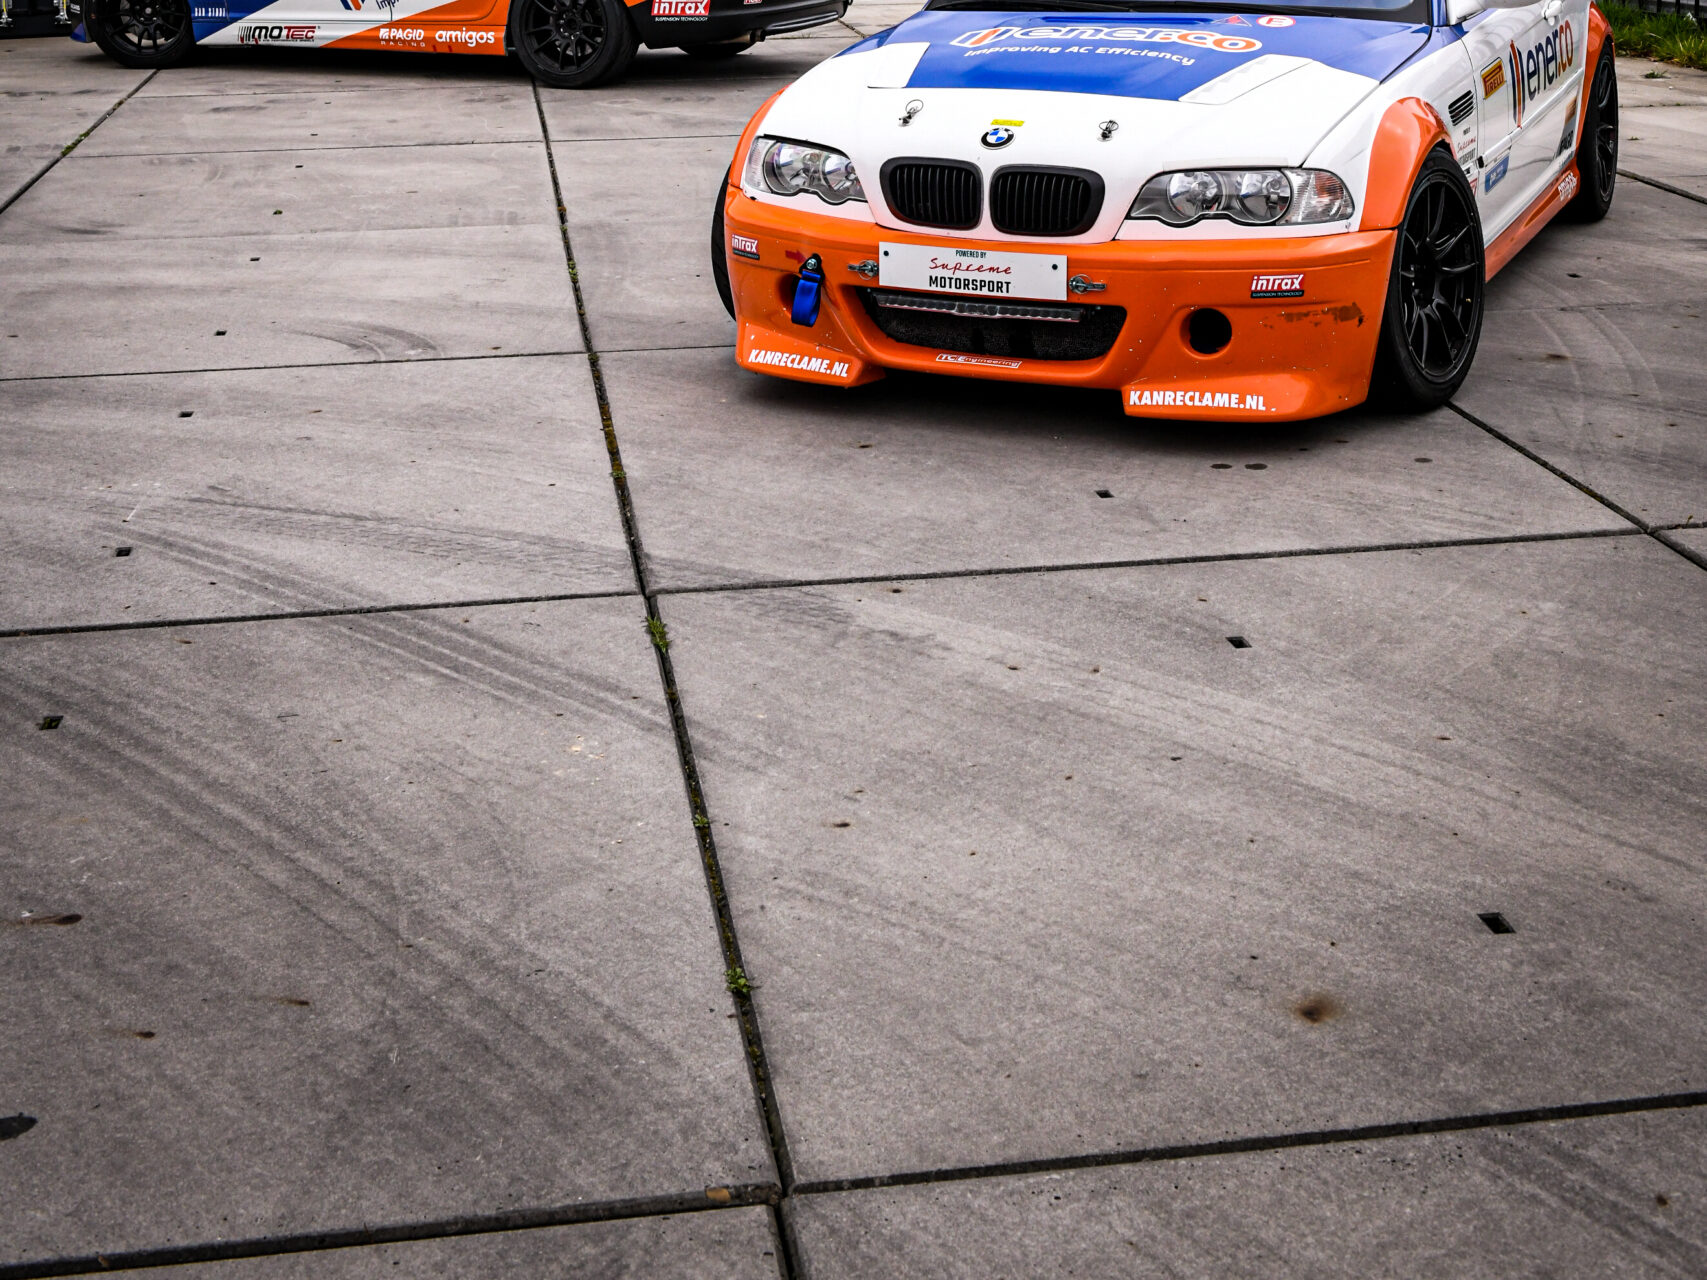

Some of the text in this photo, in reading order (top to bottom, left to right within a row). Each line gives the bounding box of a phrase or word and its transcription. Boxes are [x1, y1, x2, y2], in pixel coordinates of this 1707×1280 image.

[390, 28, 424, 40] PAGID
[435, 27, 495, 47] amigos
[964, 44, 1195, 66] Improving AC Efficiency
[956, 250, 979, 258] POWERED
[929, 258, 1012, 275] Supreme
[929, 275, 1011, 293] MOTORSPORT
[748, 349, 848, 377] KANRECLAME.NL
[1129, 391, 1266, 411] KANRECLAME.NL
